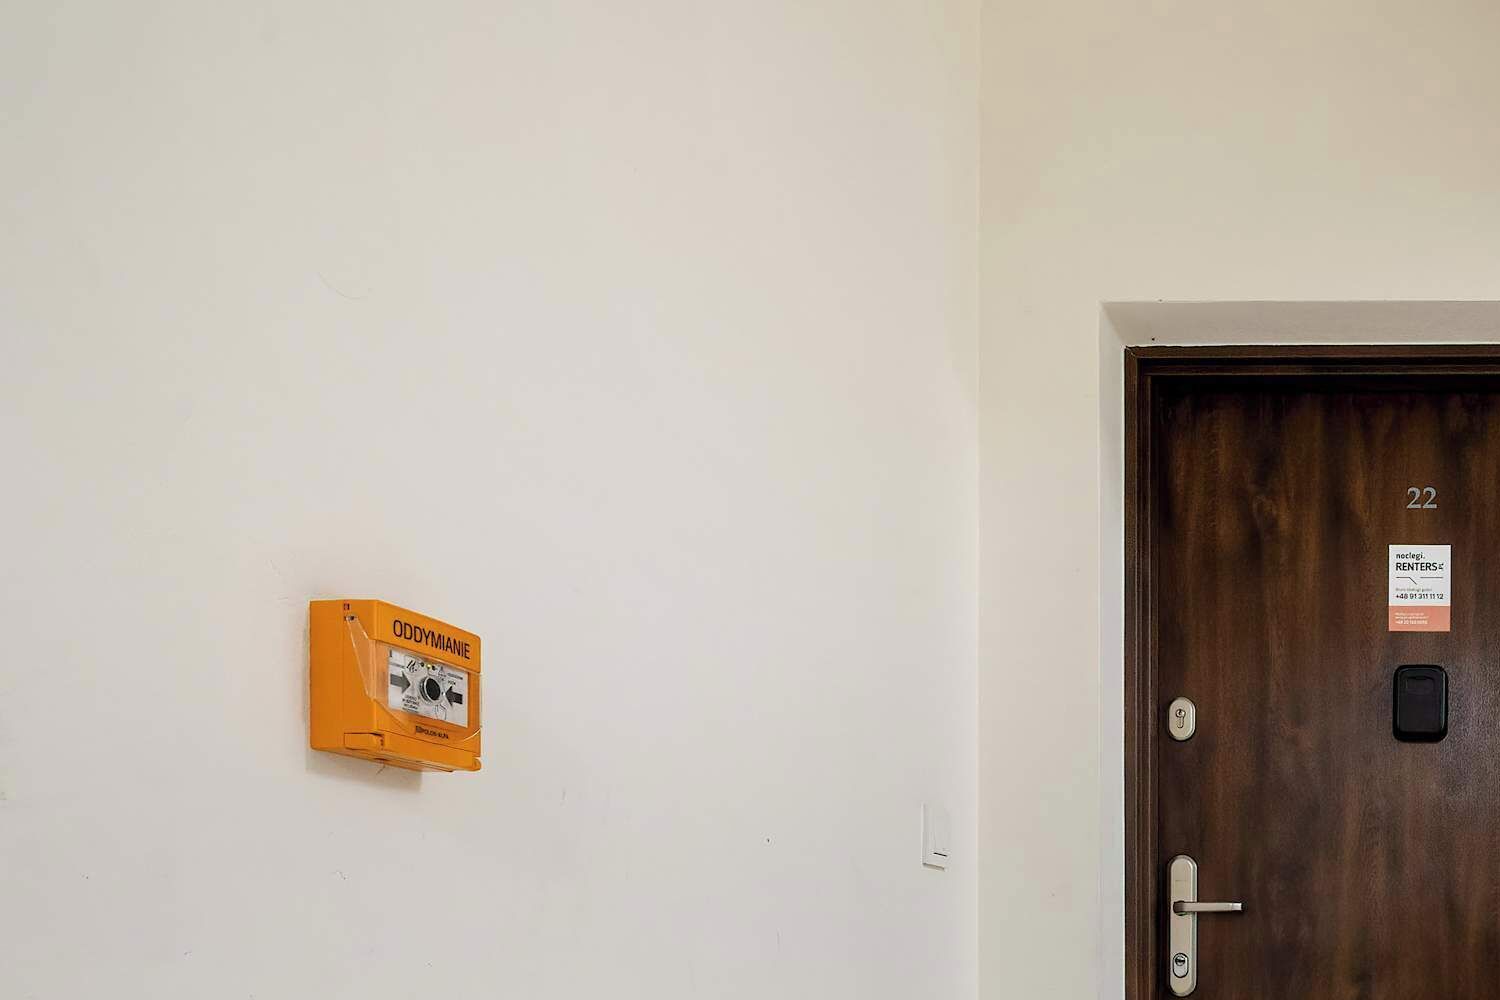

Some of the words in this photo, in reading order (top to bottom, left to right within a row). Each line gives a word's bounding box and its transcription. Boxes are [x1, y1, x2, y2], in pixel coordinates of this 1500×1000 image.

[1406, 486, 1438, 509] 22
[1395, 562, 1438, 571] RENTERS
[392, 619, 471, 660] ODDYMIANIE
